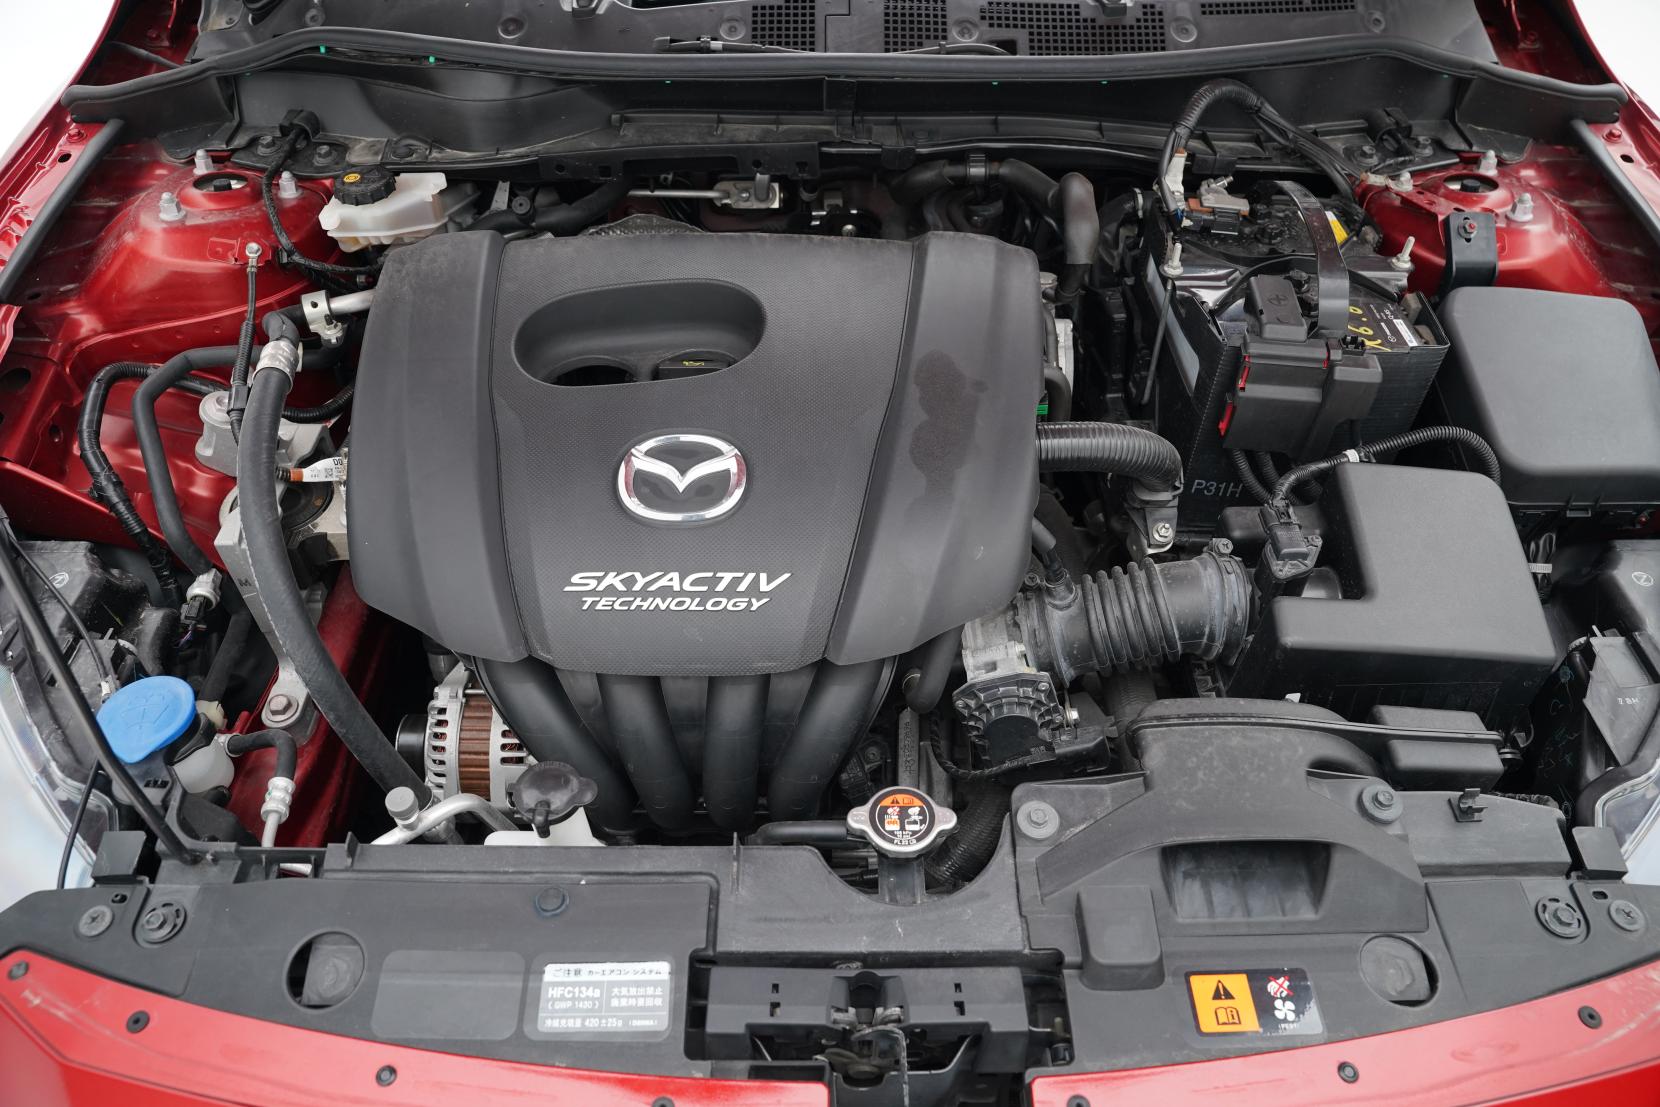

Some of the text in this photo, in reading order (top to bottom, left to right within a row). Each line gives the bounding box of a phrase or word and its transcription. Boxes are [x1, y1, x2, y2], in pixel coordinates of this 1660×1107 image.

[1191, 479, 1243, 498] P31H
[563, 570, 793, 593] SKYACTIV
[580, 596, 771, 612] TECHNOLOGY
[548, 986, 601, 998] HFC134a
